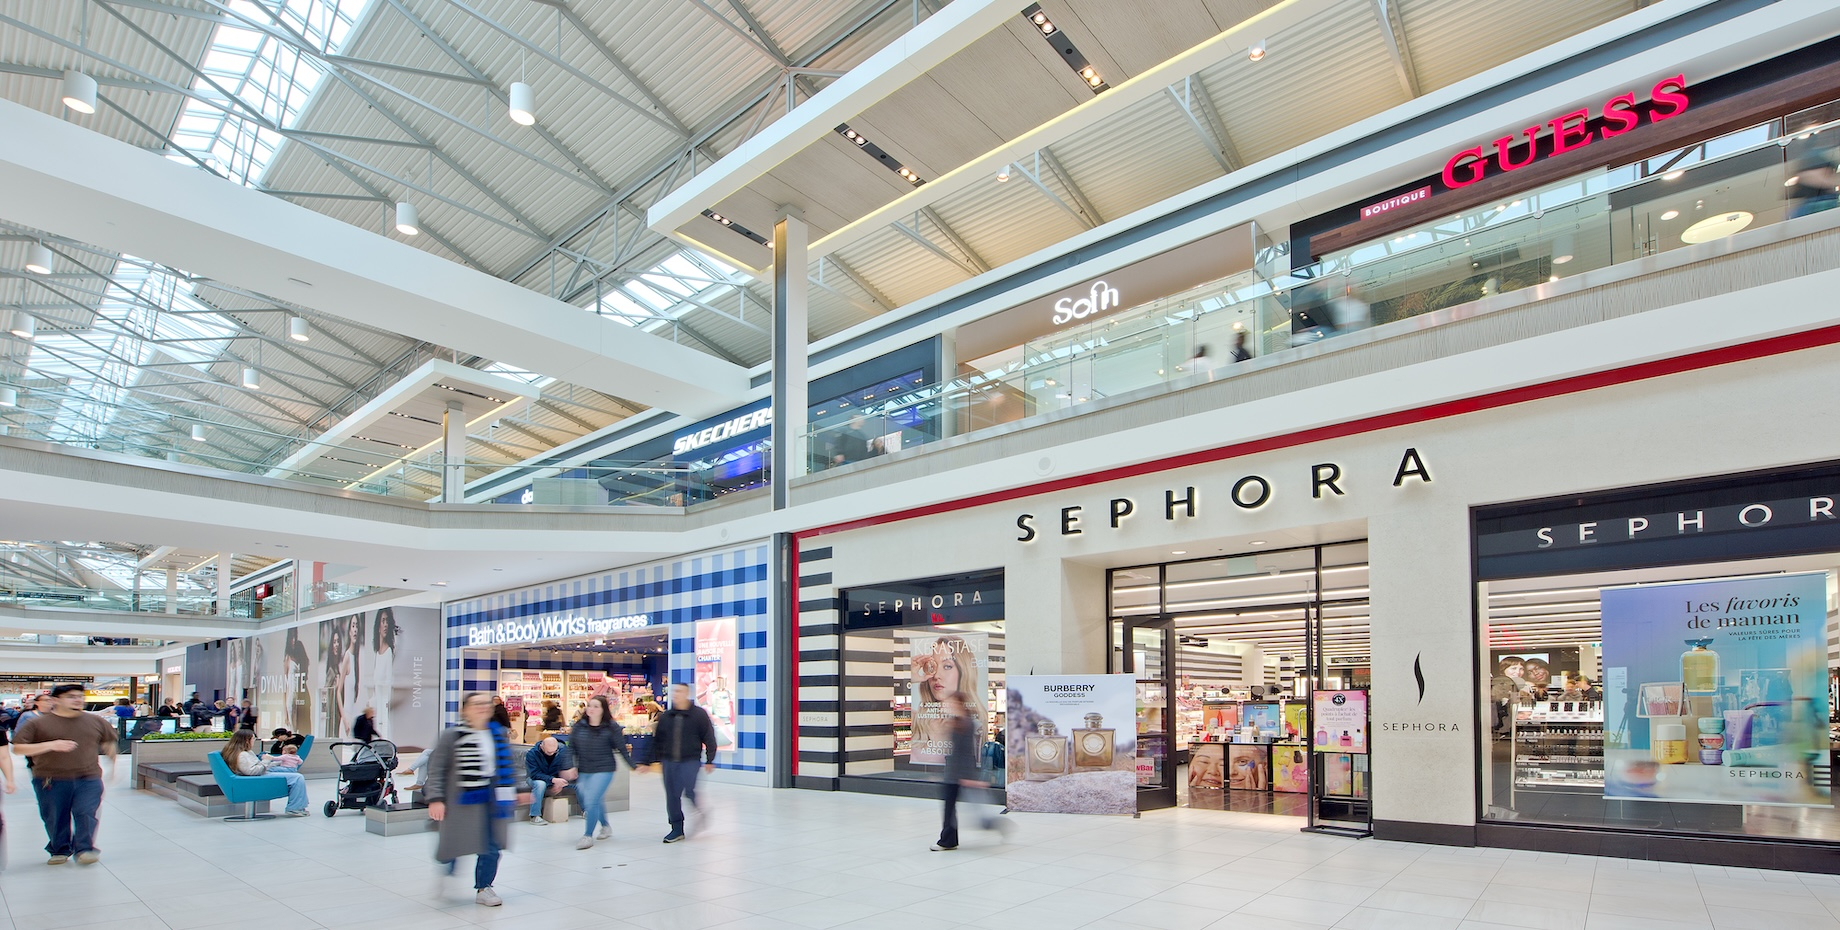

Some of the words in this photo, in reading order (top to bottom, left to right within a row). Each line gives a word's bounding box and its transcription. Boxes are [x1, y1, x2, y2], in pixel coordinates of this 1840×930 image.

[1442, 73, 1690, 189] GUESS
[1365, 190, 1427, 217] BOUTIQUE
[1017, 448, 1432, 543] SEPHORA
[1536, 496, 1837, 548] SEPHOR
[863, 590, 983, 616] SEPHORA
[1686, 600, 1720, 613] Les
[1725, 593, 1800, 614] favoris
[469, 626, 495, 646] Bath
[495, 624, 506, 643] &
[506, 619, 541, 643] Body
[540, 615, 586, 637] Works
[587, 614, 648, 635] fragrances
[1687, 616, 1711, 629] de
[1718, 613, 1801, 628] maman
[260, 672, 306, 694] DYNAMTE
[412, 656, 423, 708] DYNAMITE
[1043, 684, 1095, 692] BURBERRY
[1382, 722, 1460, 731] SEPHORA
[926, 740, 954, 748] GLOSS
[1729, 770, 1804, 779] SEPHORA
